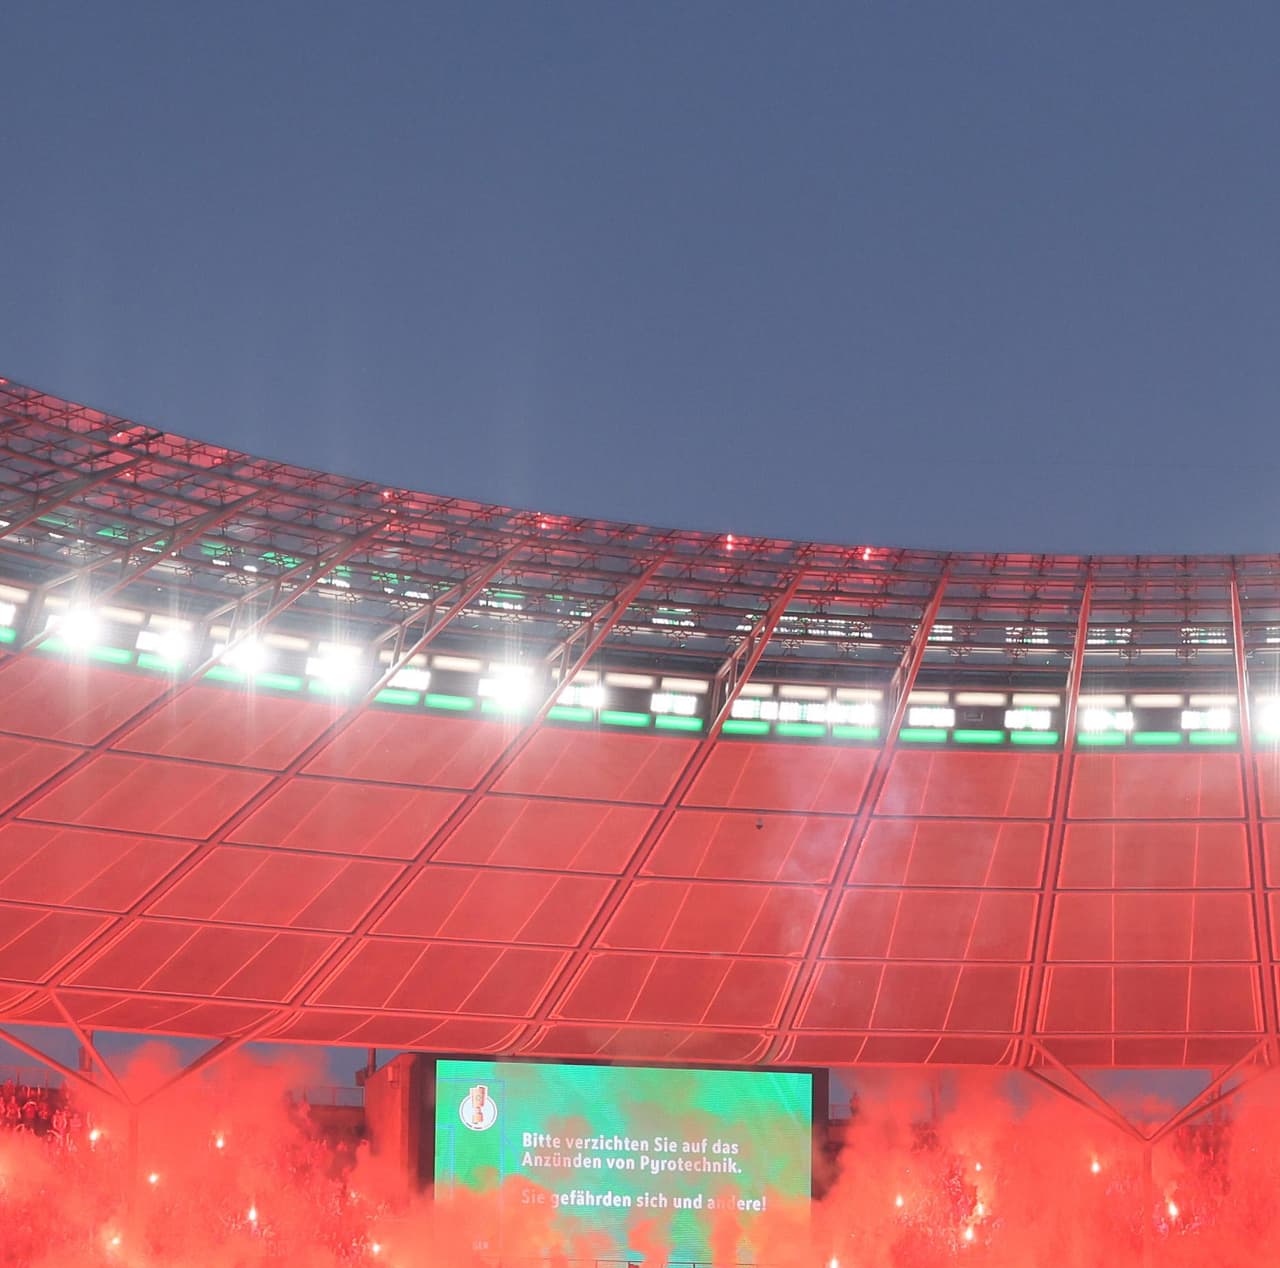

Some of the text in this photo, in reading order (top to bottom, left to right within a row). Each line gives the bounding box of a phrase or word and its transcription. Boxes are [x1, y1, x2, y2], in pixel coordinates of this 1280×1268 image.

[522, 1132, 739, 1154] Bitte verzichten Sie auf das
[521, 1151, 742, 1175] Anzünden von Pyrotechnik.
[521, 1189, 545, 1204] Sie
[551, 1190, 632, 1208] gefährden
[636, 1192, 668, 1208] sich
[673, 1194, 703, 1209] und
